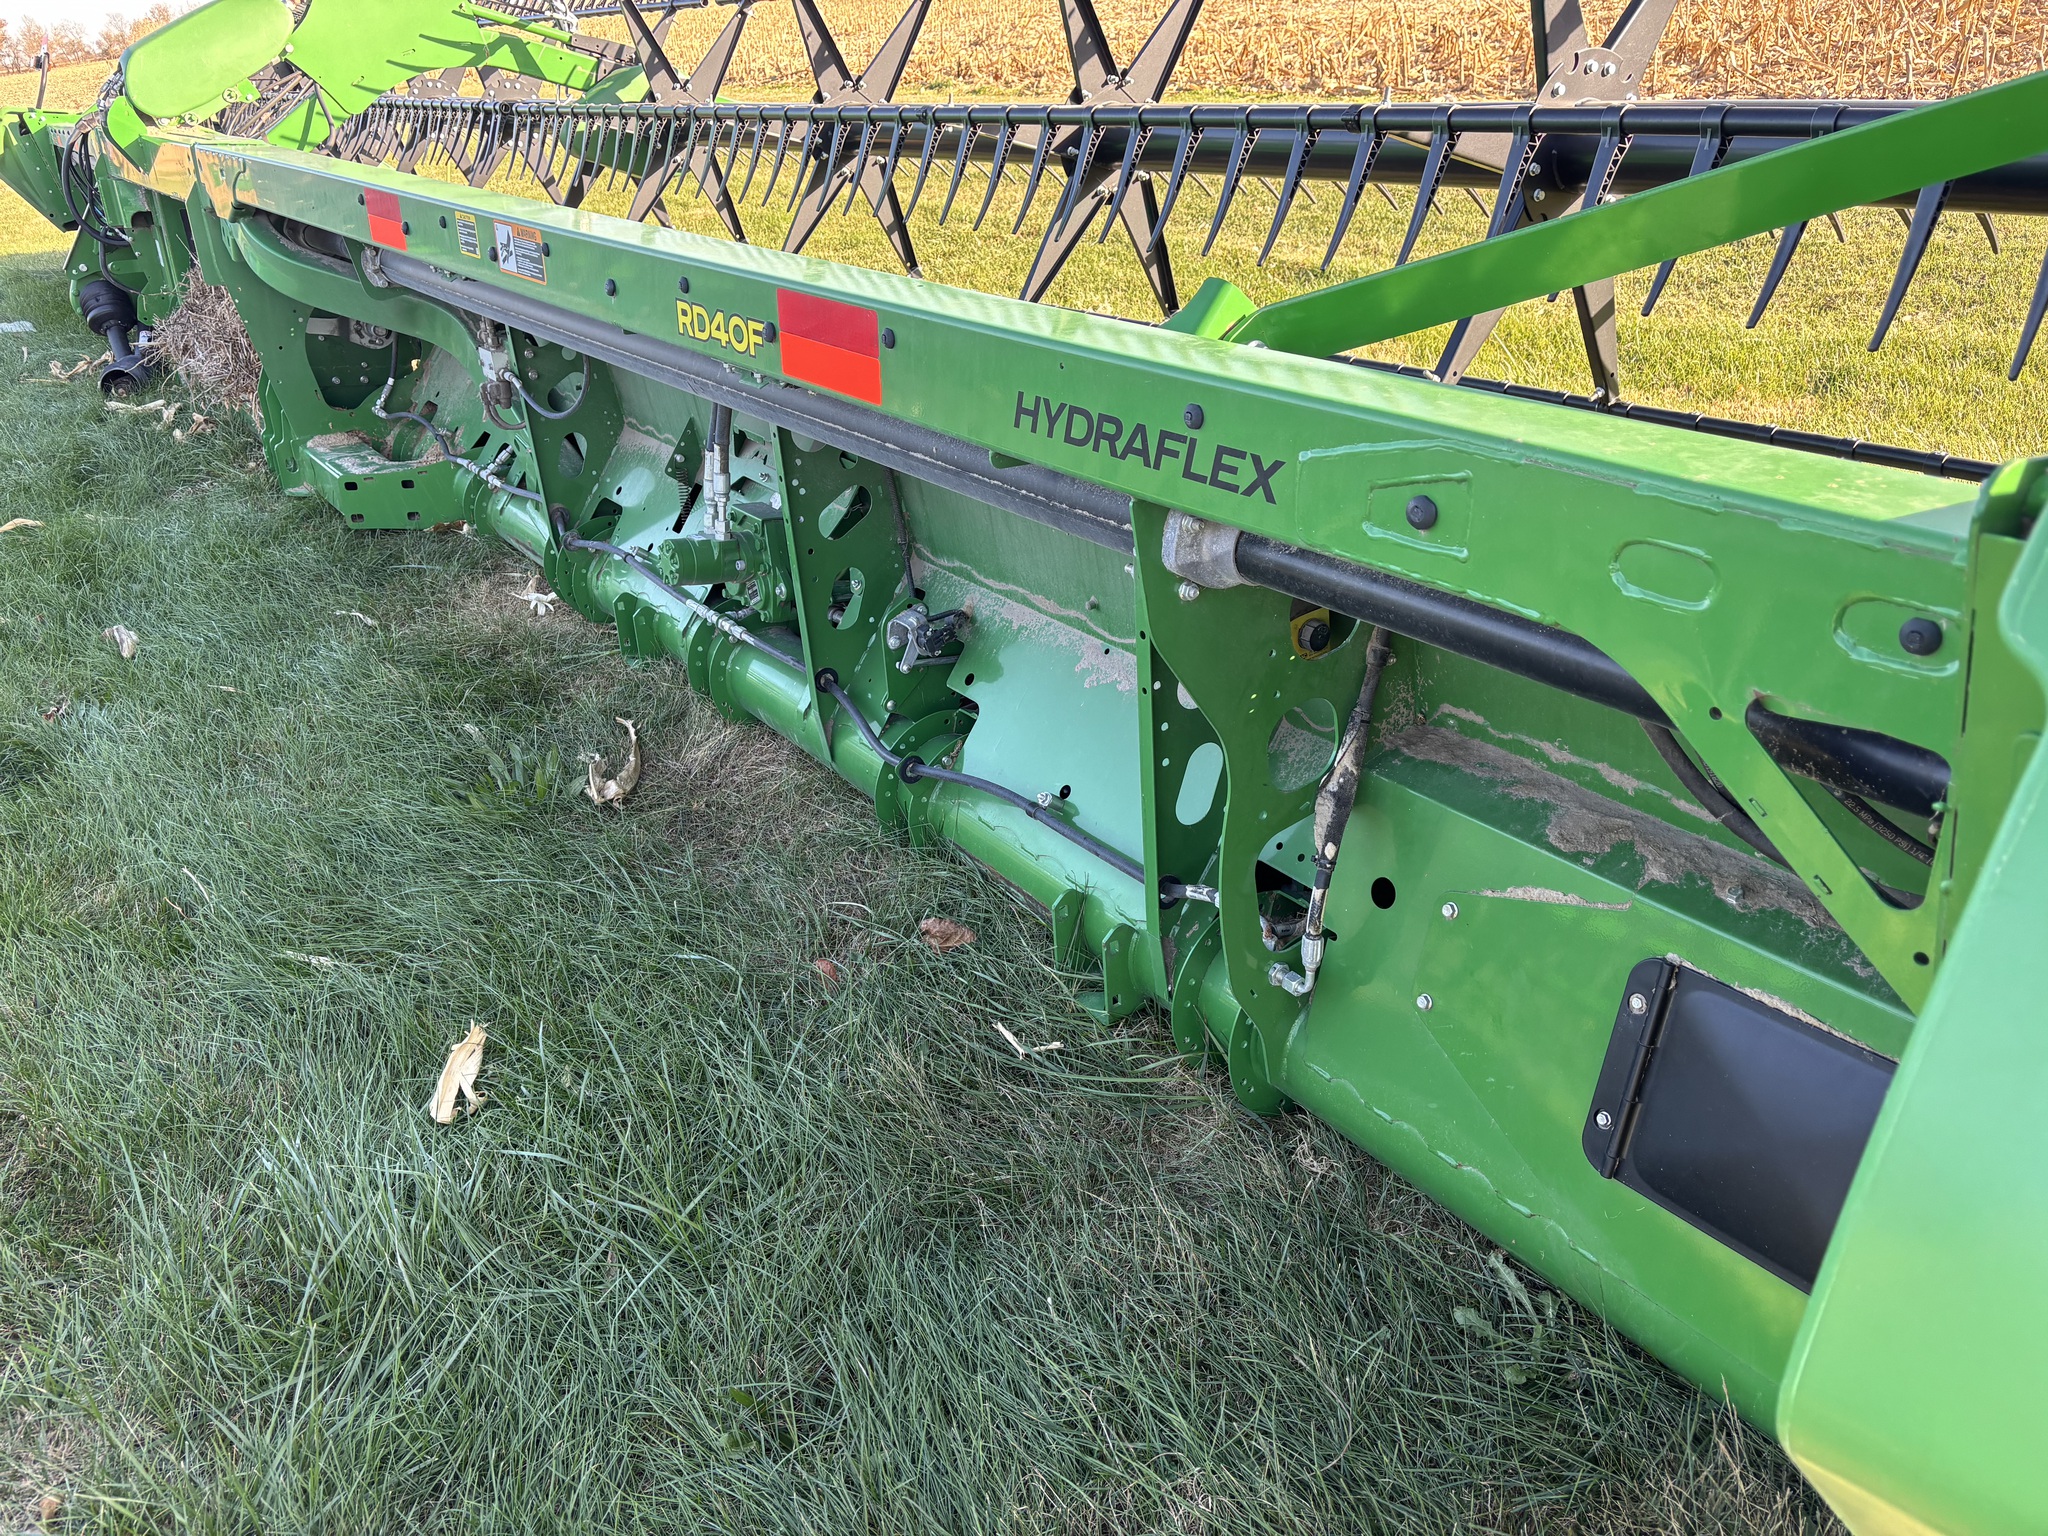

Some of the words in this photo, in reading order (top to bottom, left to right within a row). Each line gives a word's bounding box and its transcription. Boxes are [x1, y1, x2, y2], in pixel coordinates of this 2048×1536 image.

[675, 298, 765, 358] RD40F
[1013, 391, 1286, 505] HYDRAFLEX
[1844, 798, 1861, 813] 22.5
[1859, 810, 1874, 825] MPa
